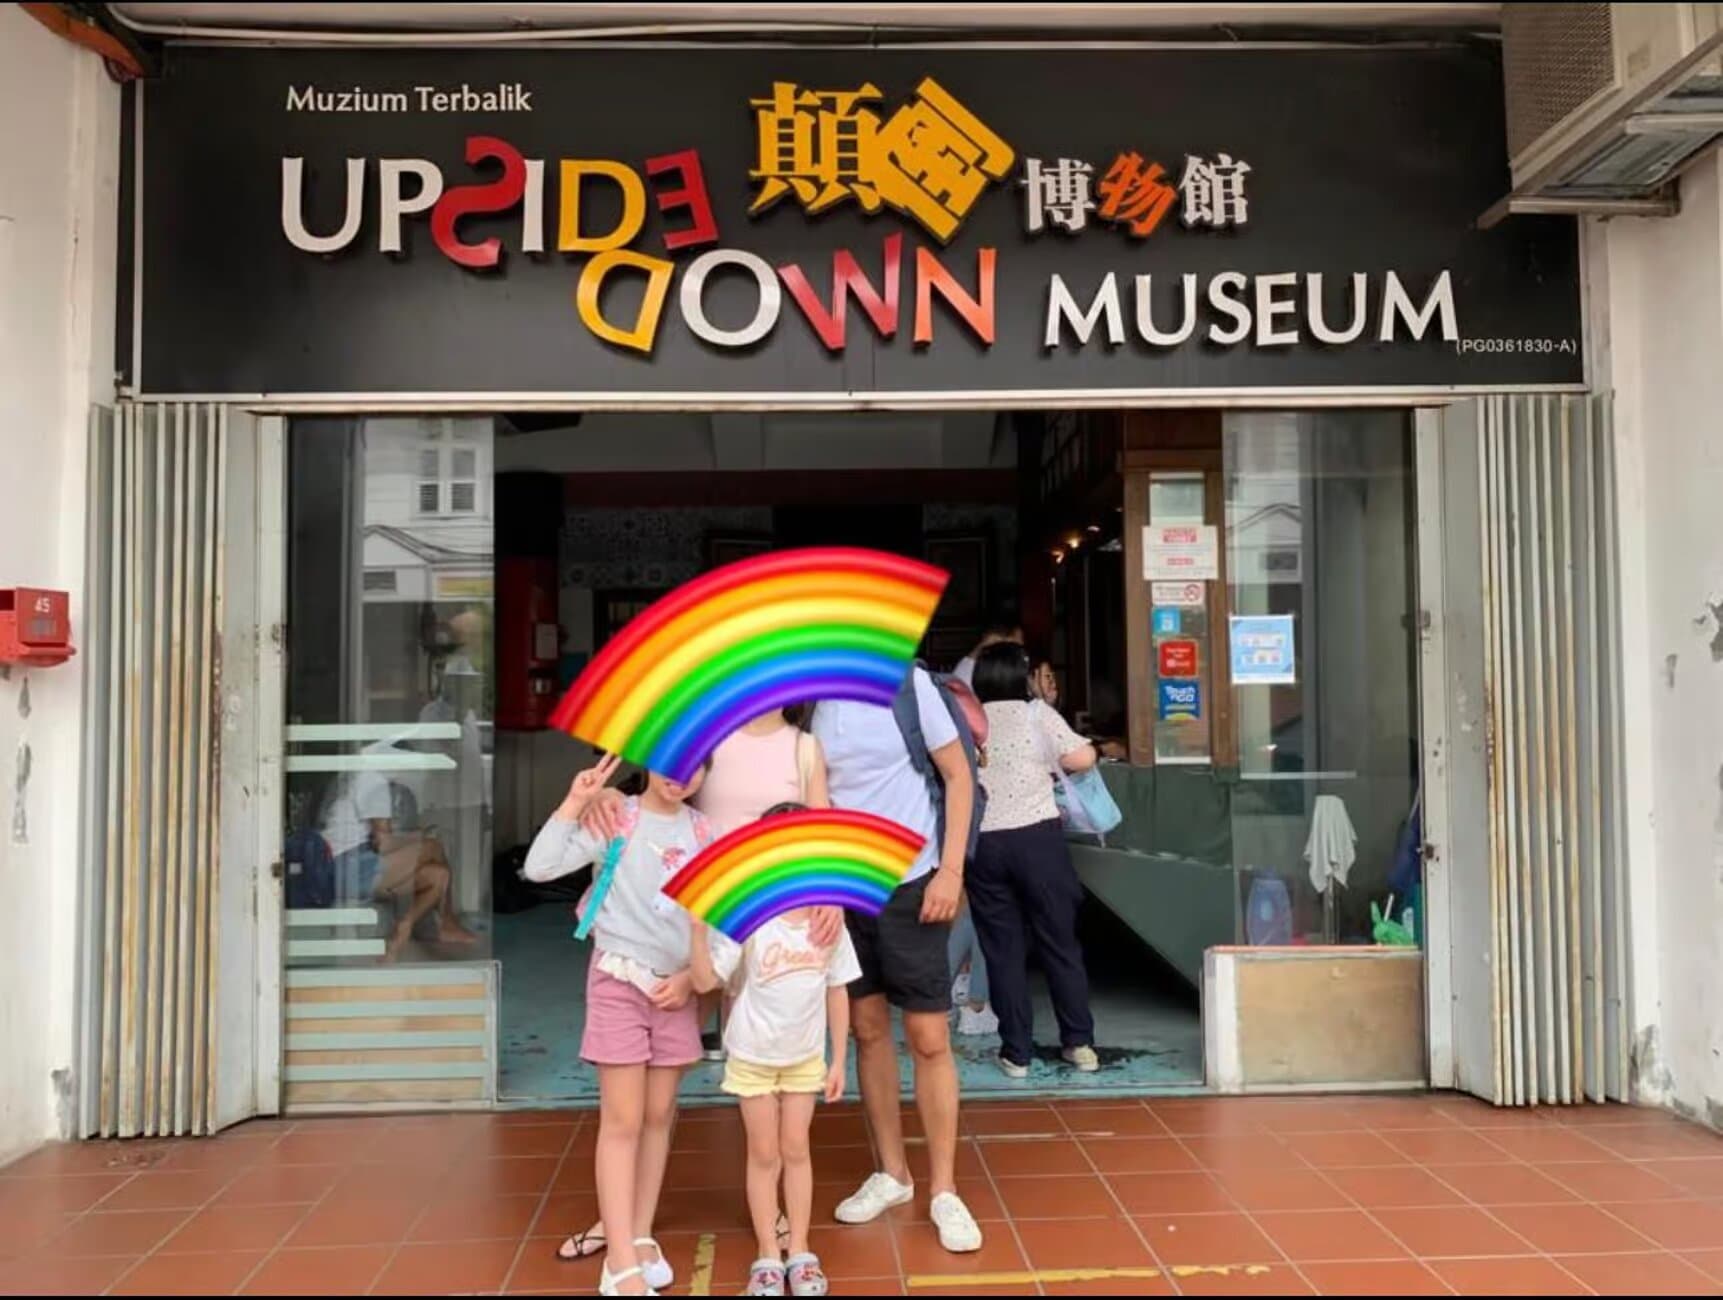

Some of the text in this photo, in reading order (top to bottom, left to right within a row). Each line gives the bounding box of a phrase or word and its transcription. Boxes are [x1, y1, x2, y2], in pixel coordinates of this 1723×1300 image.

[286, 83, 533, 112] Muzium Terbalik
[281, 136, 719, 267] UPSIDE
[576, 232, 1458, 352] DOWN MUSEUM
[1456, 338, 1577, 356] (PG0361830-A)
